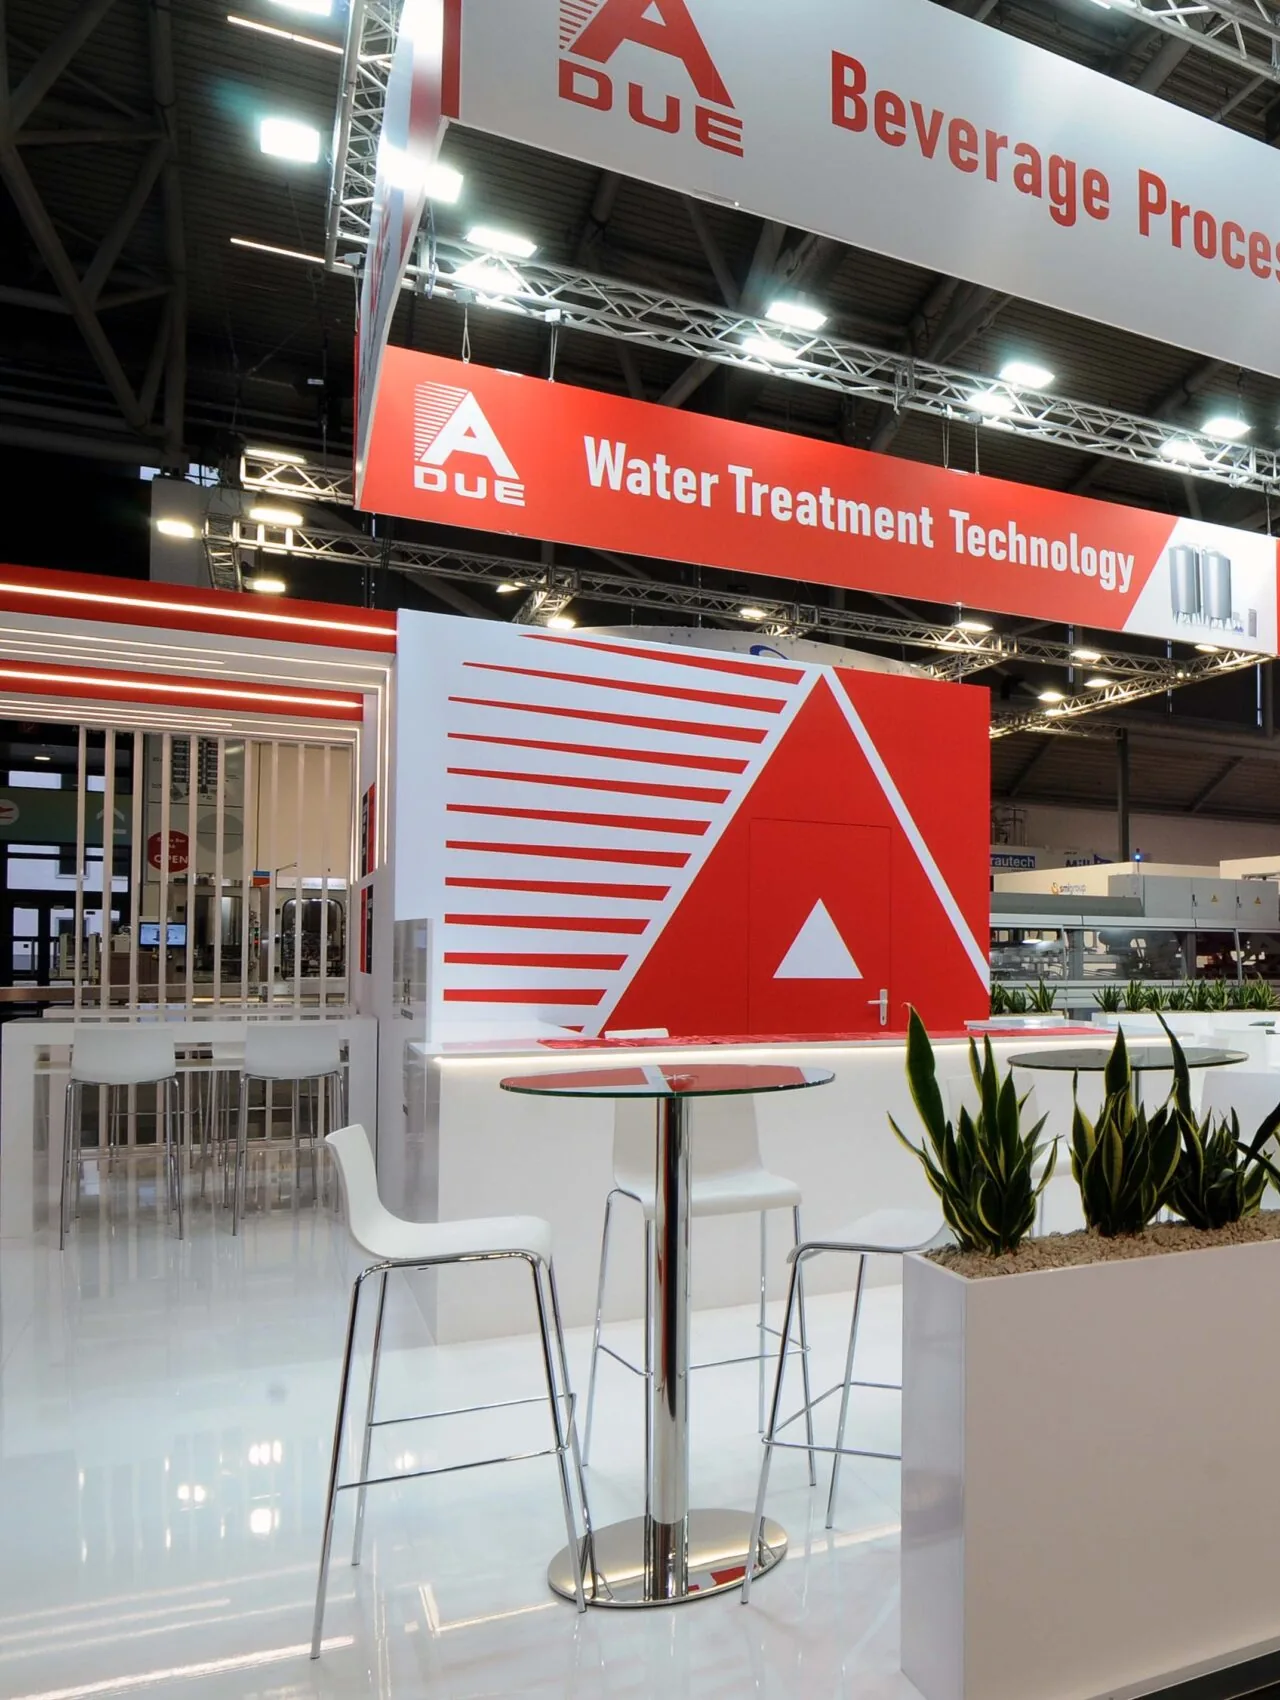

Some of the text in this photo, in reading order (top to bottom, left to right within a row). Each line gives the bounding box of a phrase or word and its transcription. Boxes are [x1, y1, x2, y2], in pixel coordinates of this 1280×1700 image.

[831, 49, 1110, 227] Beverage
[583, 434, 1135, 594] Water Treatment Technology
